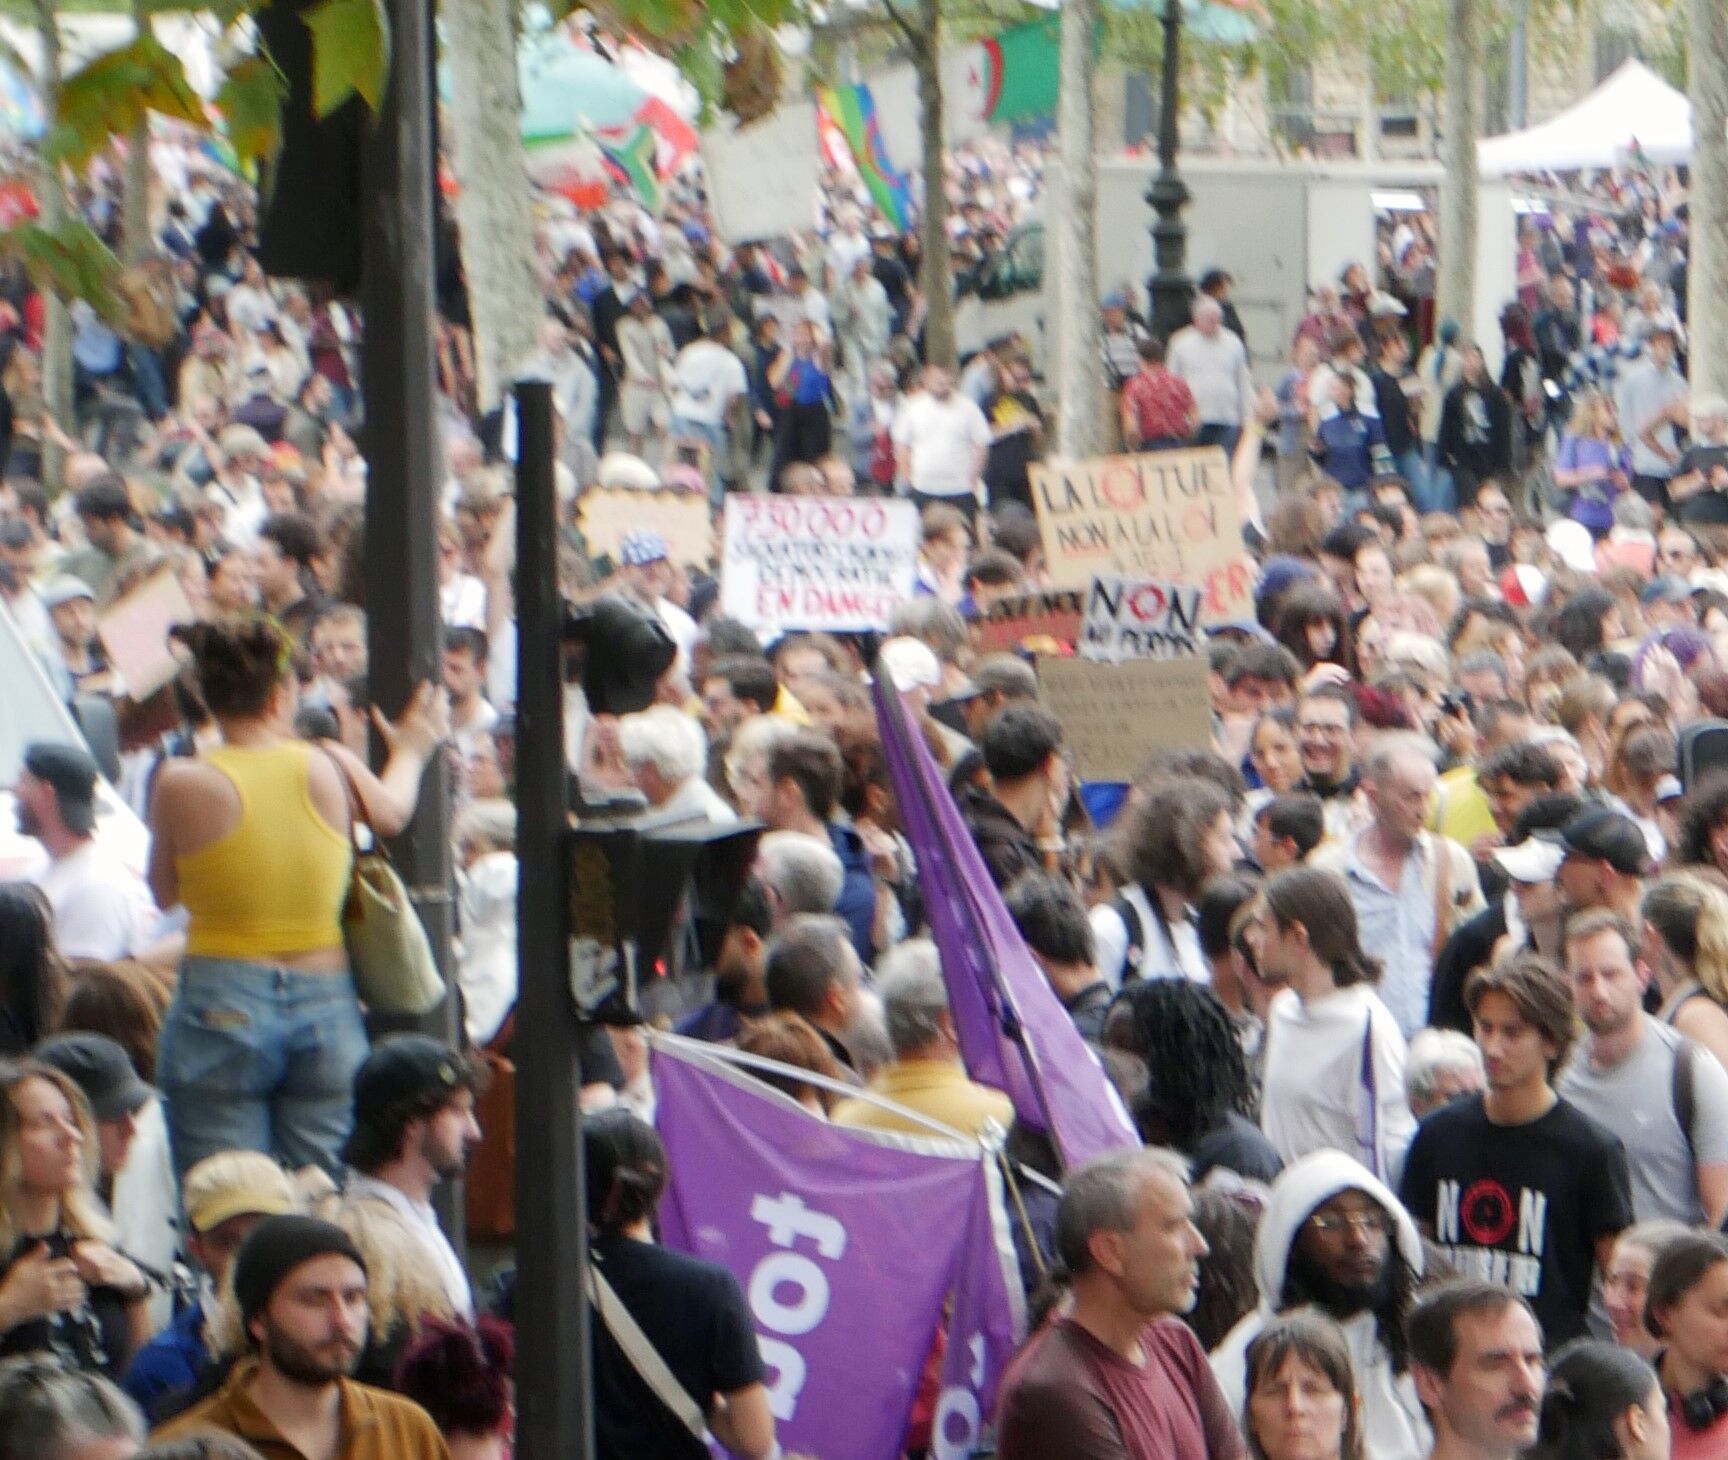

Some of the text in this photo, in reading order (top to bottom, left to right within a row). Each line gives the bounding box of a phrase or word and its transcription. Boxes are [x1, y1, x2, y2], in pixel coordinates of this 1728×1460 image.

[1039, 455, 1228, 513] LA LOI TUE
[1057, 517, 1109, 551] NON
[1090, 574, 1202, 631] NON
[1437, 1178, 1547, 1257] NON
